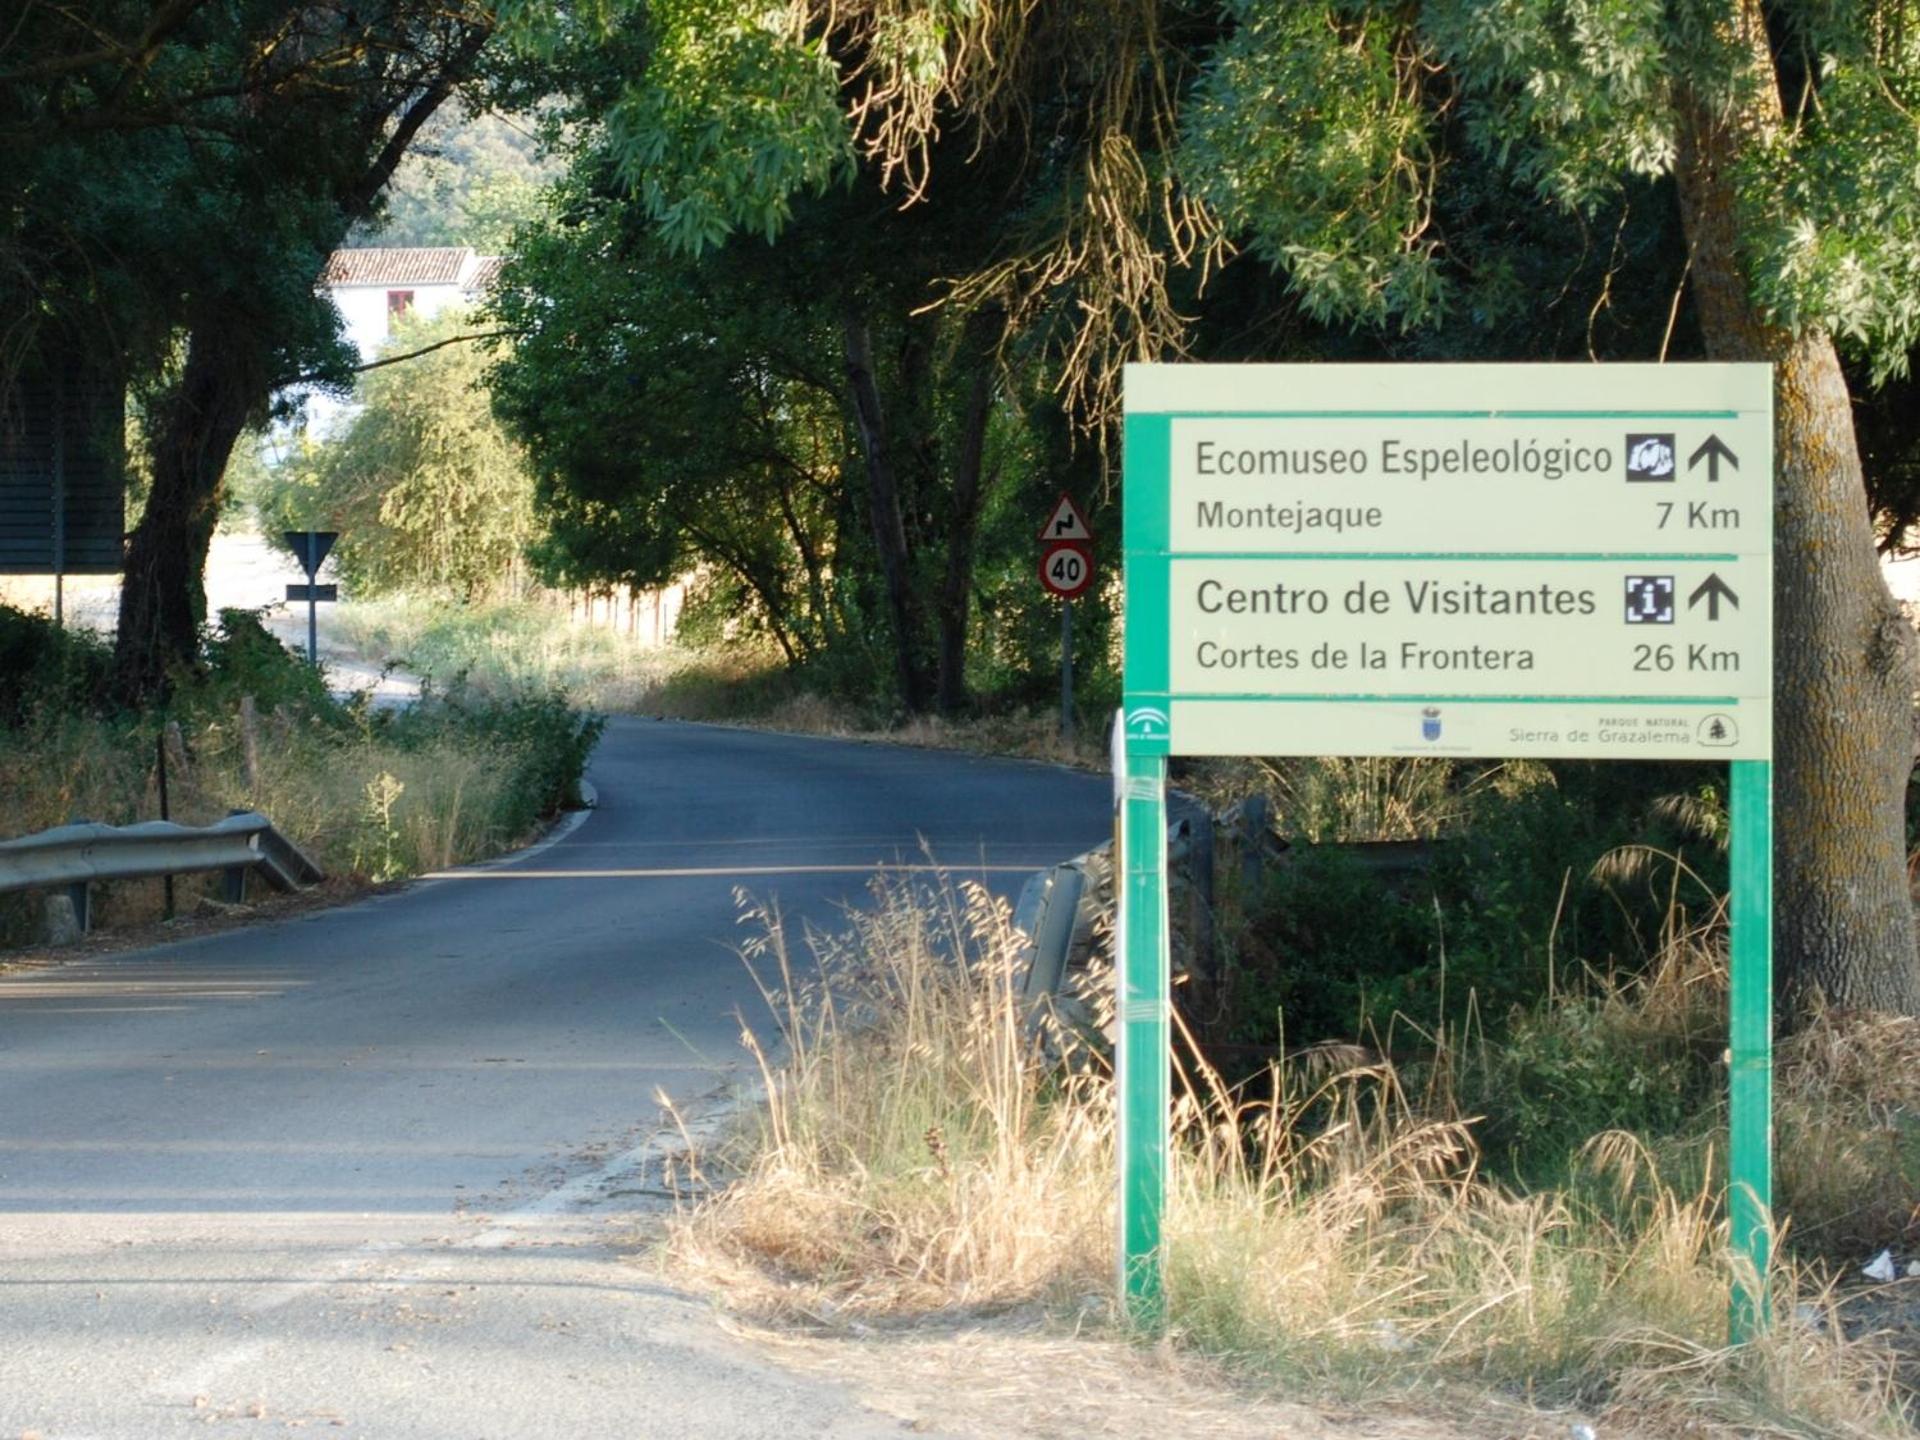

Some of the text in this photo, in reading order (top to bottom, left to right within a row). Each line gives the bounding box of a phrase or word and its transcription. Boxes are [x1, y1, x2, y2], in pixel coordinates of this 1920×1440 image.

[1197, 438, 1613, 481] Ecomuseo Espeleológico
[1197, 500, 1382, 534] Montejaque
[1656, 502, 1740, 529] 7 Km
[1052, 557, 1080, 582] 40
[1196, 580, 1596, 615] Centro de Visitantes
[1196, 641, 1534, 670] Cortes de la Frontera
[1633, 643, 1740, 672] 26 Km
[1510, 729, 1690, 743] Sierra de Grazalema
[1599, 718, 1689, 728] PARQUE NATURAL
